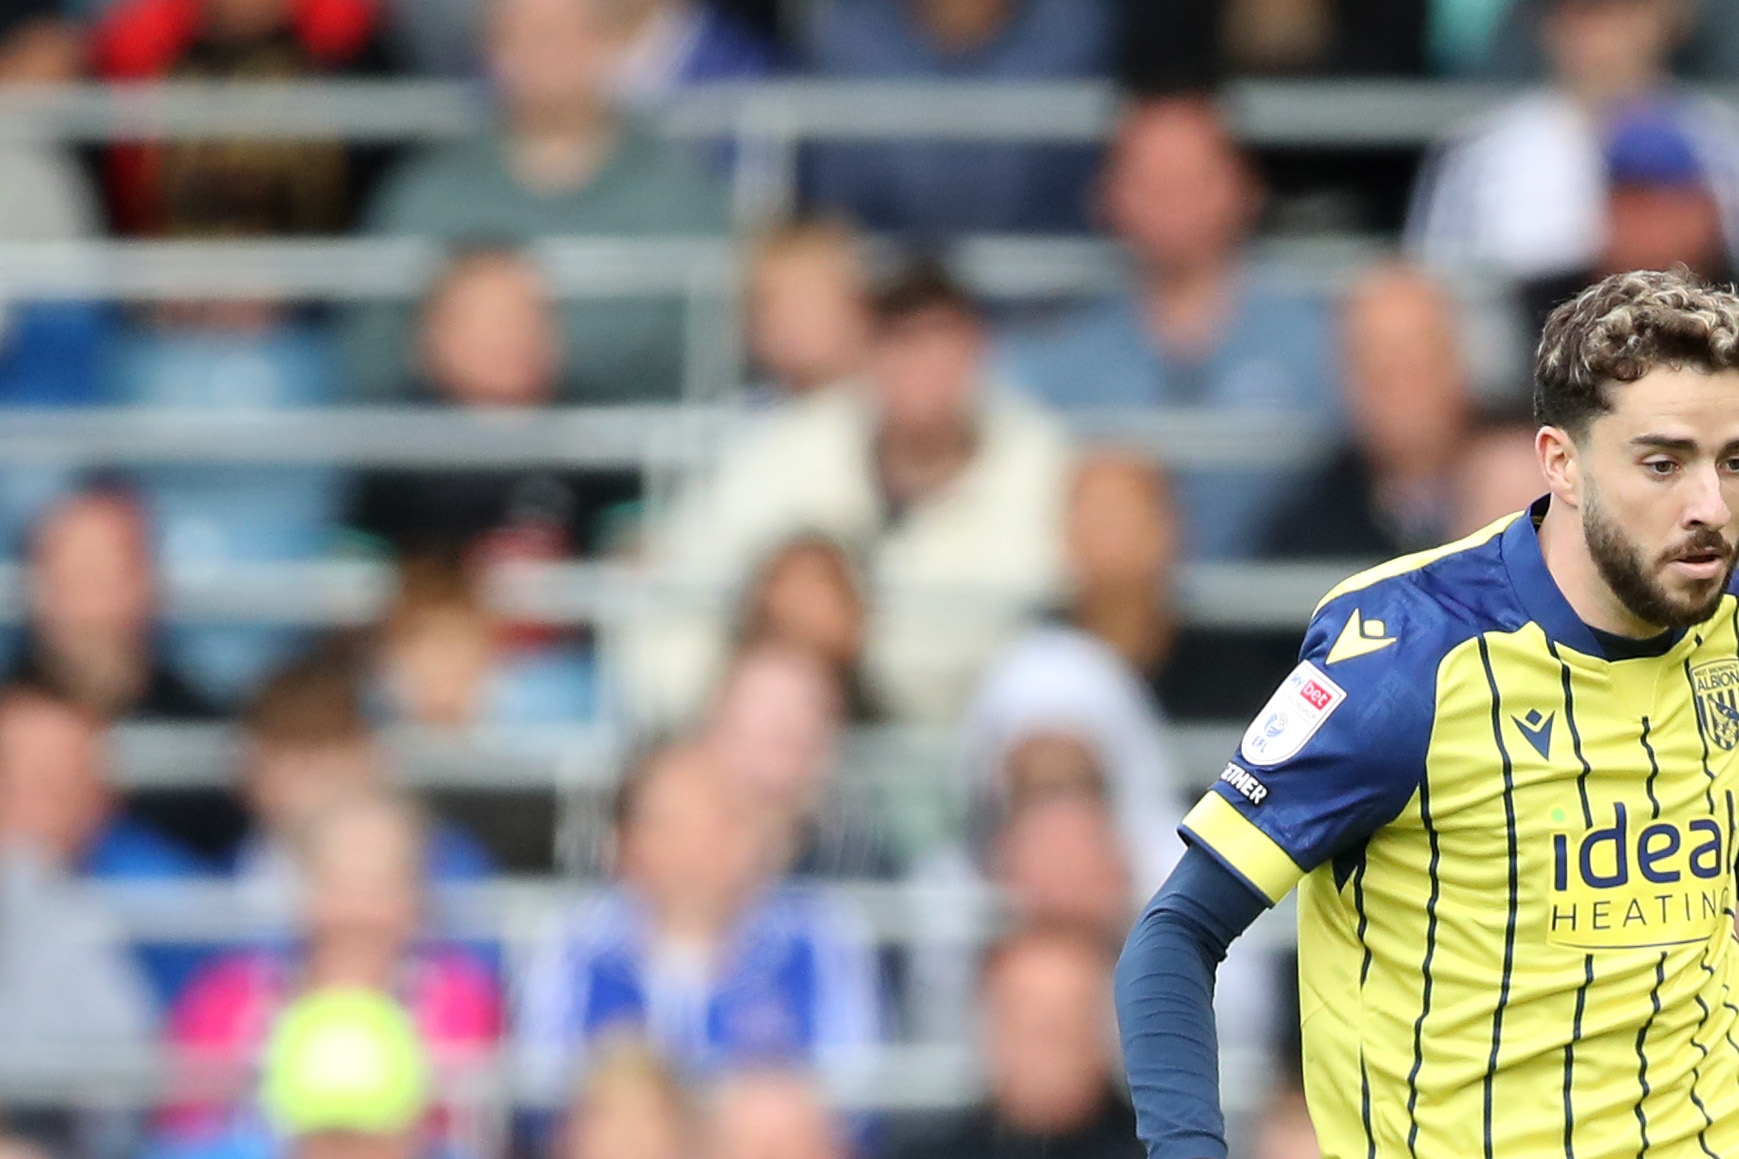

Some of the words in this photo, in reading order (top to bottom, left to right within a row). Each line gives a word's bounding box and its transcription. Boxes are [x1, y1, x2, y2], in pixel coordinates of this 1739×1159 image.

[1697, 670, 1739, 691] ALBION
[1302, 681, 1328, 707] bet
[1553, 789, 1736, 892] ideal
